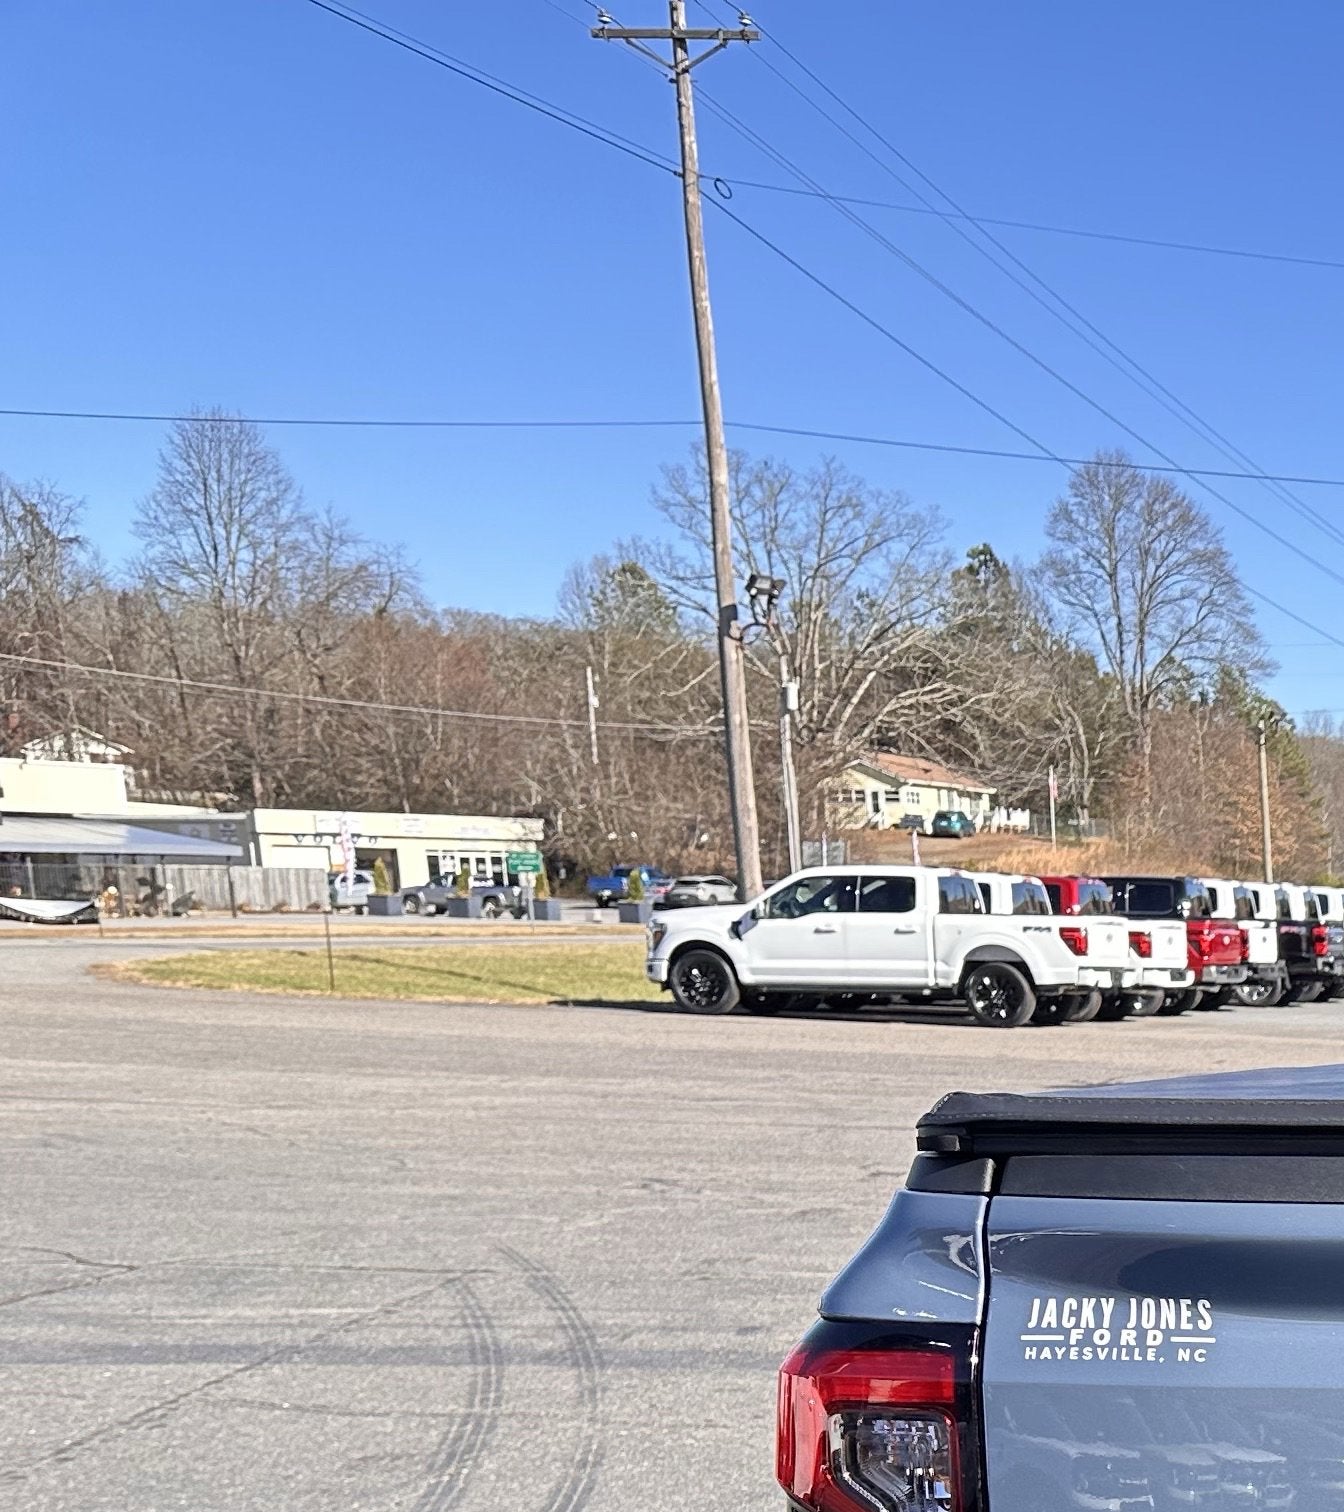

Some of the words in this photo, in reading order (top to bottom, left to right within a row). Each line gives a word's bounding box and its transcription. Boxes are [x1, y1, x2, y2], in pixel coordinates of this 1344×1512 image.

[1027, 1297, 1115, 1329] JACKY
[1126, 1297, 1213, 1331] JONES
[1069, 1328, 1164, 1346] FORD
[1024, 1346, 1166, 1363] HAYESVILLE,
[1177, 1348, 1208, 1362] NC
